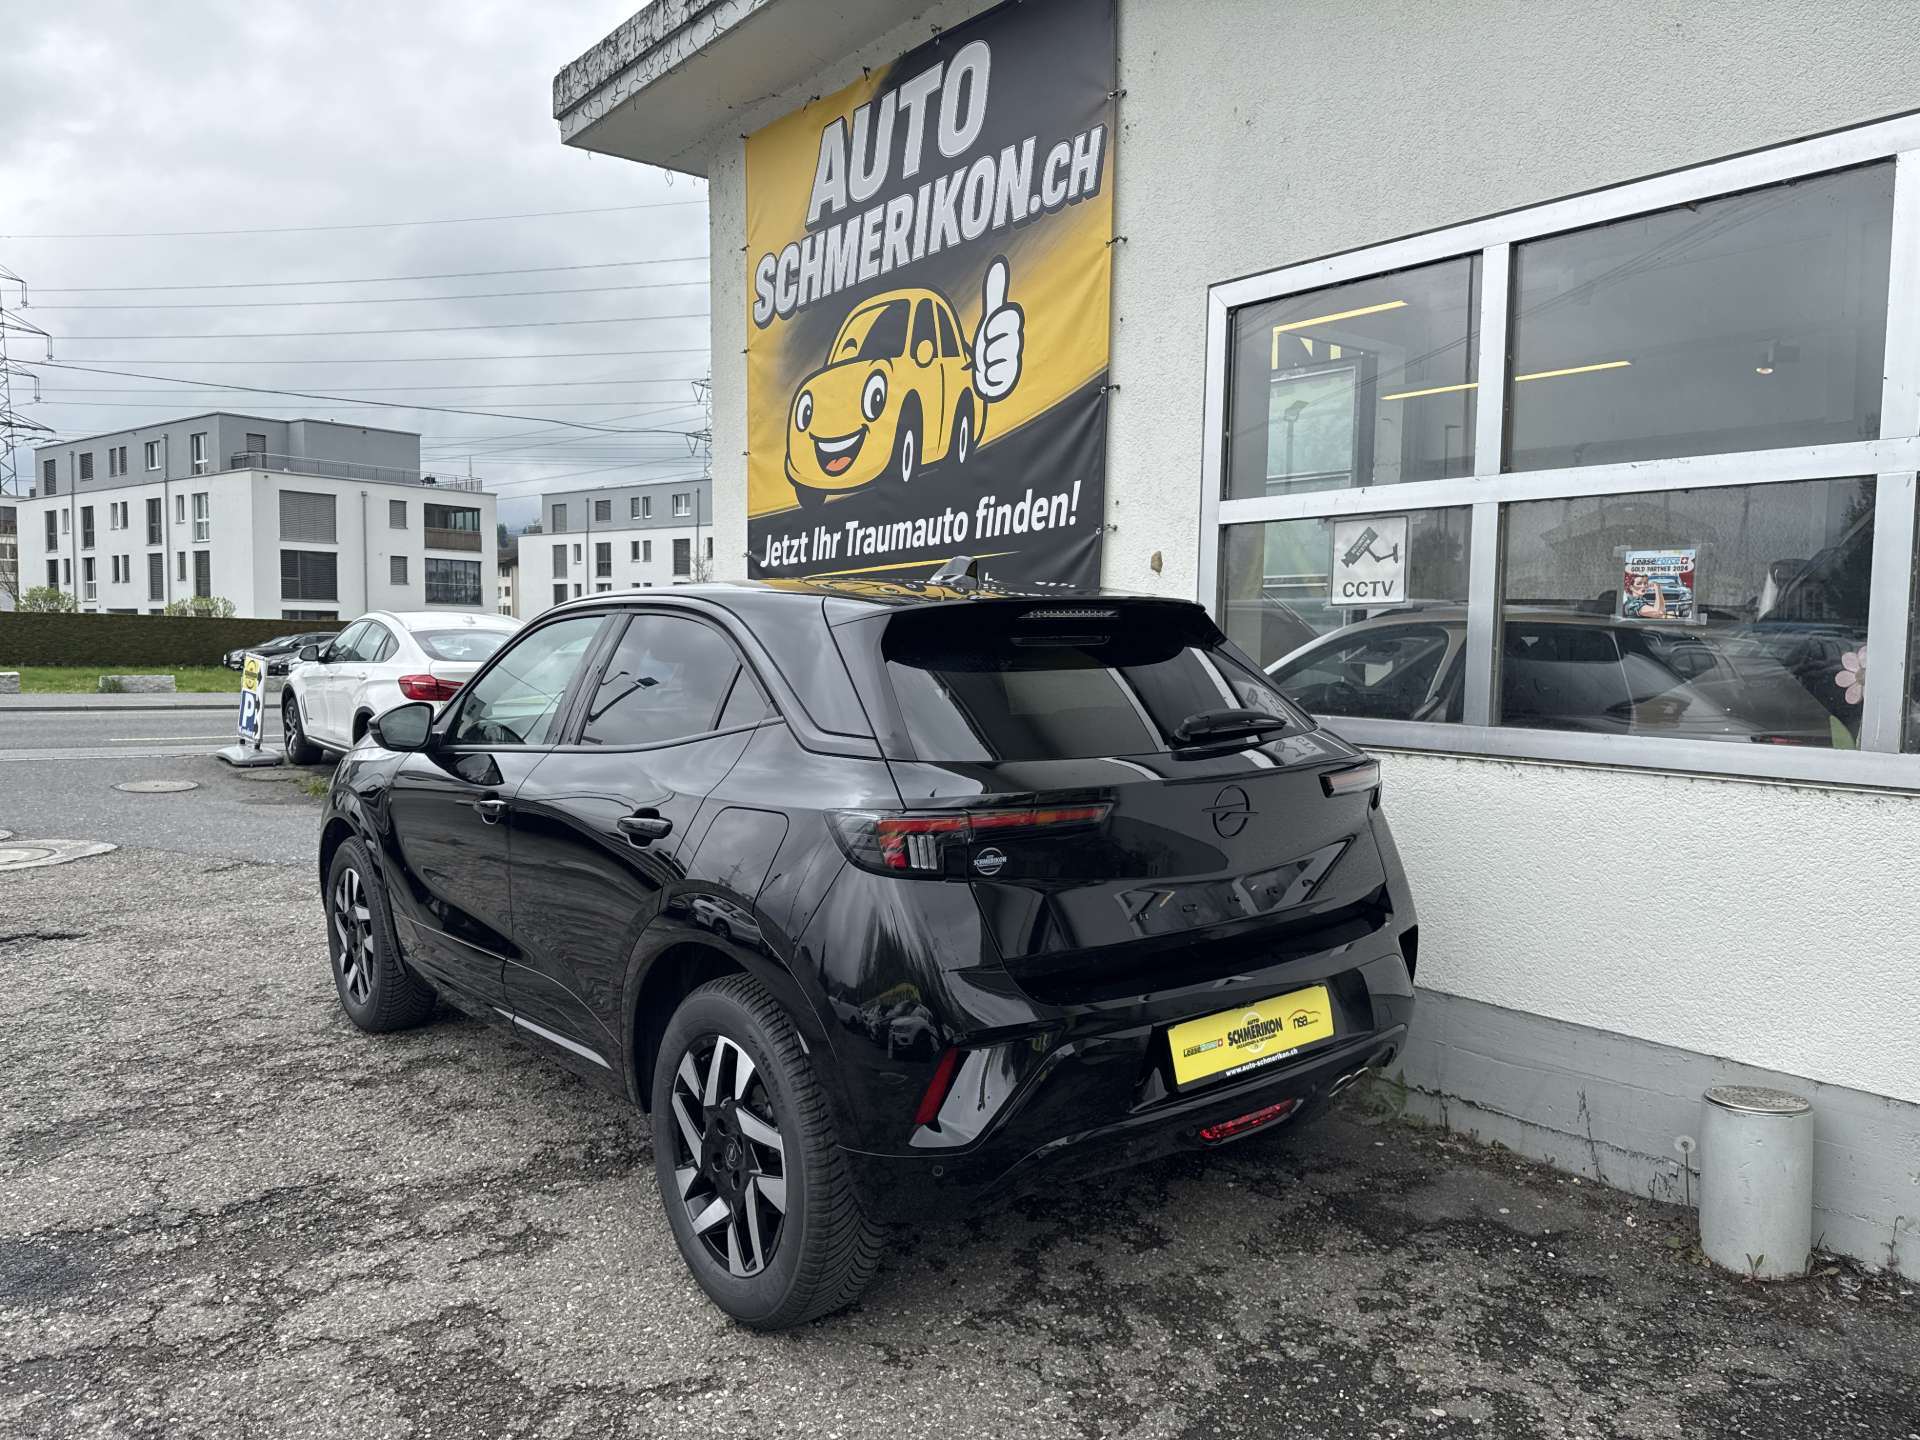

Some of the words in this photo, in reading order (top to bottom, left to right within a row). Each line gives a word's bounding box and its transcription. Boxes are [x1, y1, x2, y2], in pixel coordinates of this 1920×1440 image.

[806, 40, 991, 229] AUTO
[754, 126, 1106, 327] SCHMERIKON.CH
[760, 534, 808, 568] Jetzt
[812, 527, 841, 561] Ihr
[845, 511, 968, 557] Traumauto
[975, 480, 1082, 540] finden!
[1342, 580, 1394, 598] CCTV
[242, 692, 255, 727] P
[1227, 1018, 1283, 1046] SCHMERIKON
